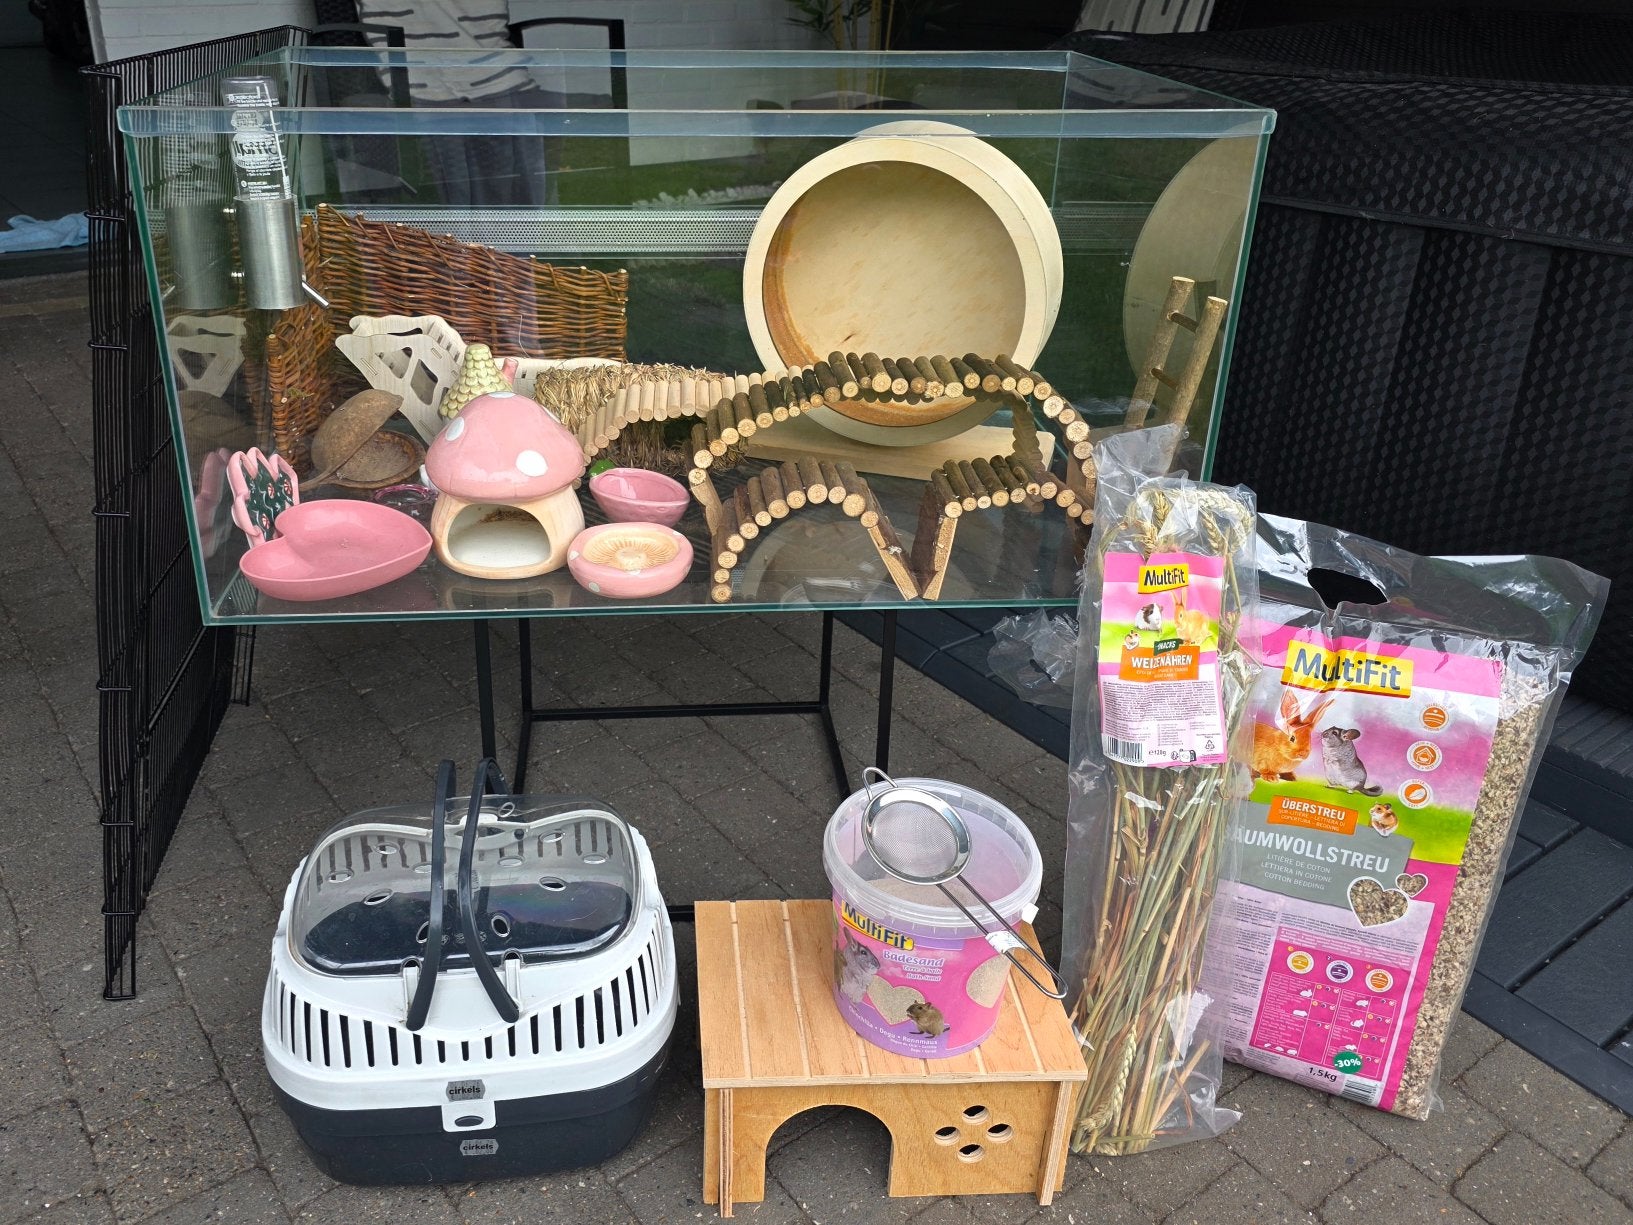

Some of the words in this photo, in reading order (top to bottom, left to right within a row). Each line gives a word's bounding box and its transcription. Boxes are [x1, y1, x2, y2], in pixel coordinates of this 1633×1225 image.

[1143, 567, 1186, 586] MultiFit
[1131, 653, 1193, 669] WEIZENÄHREN
[1293, 648, 1402, 690] MultiFit
[1282, 797, 1345, 820] ÜBERSTREU
[1227, 825, 1390, 873] AUMWOLLSTREU
[1260, 861, 1293, 874] LETTIERA
[1304, 872, 1332, 883] COTONE
[1295, 860, 1305, 868] DE
[1306, 863, 1331, 874] COTON
[1264, 871, 1292, 883] COTTON
[1293, 878, 1325, 890] BEDDING
[844, 902, 908, 949] MultiFit
[884, 950, 944, 967] Badesand
[879, 1027, 896, 1039] Degu
[902, 1035, 938, 1045] Rennmaus
[1334, 1058, 1361, 1068] -30%
[449, 1086, 481, 1095] cirkels
[463, 1143, 494, 1151] cirkels
